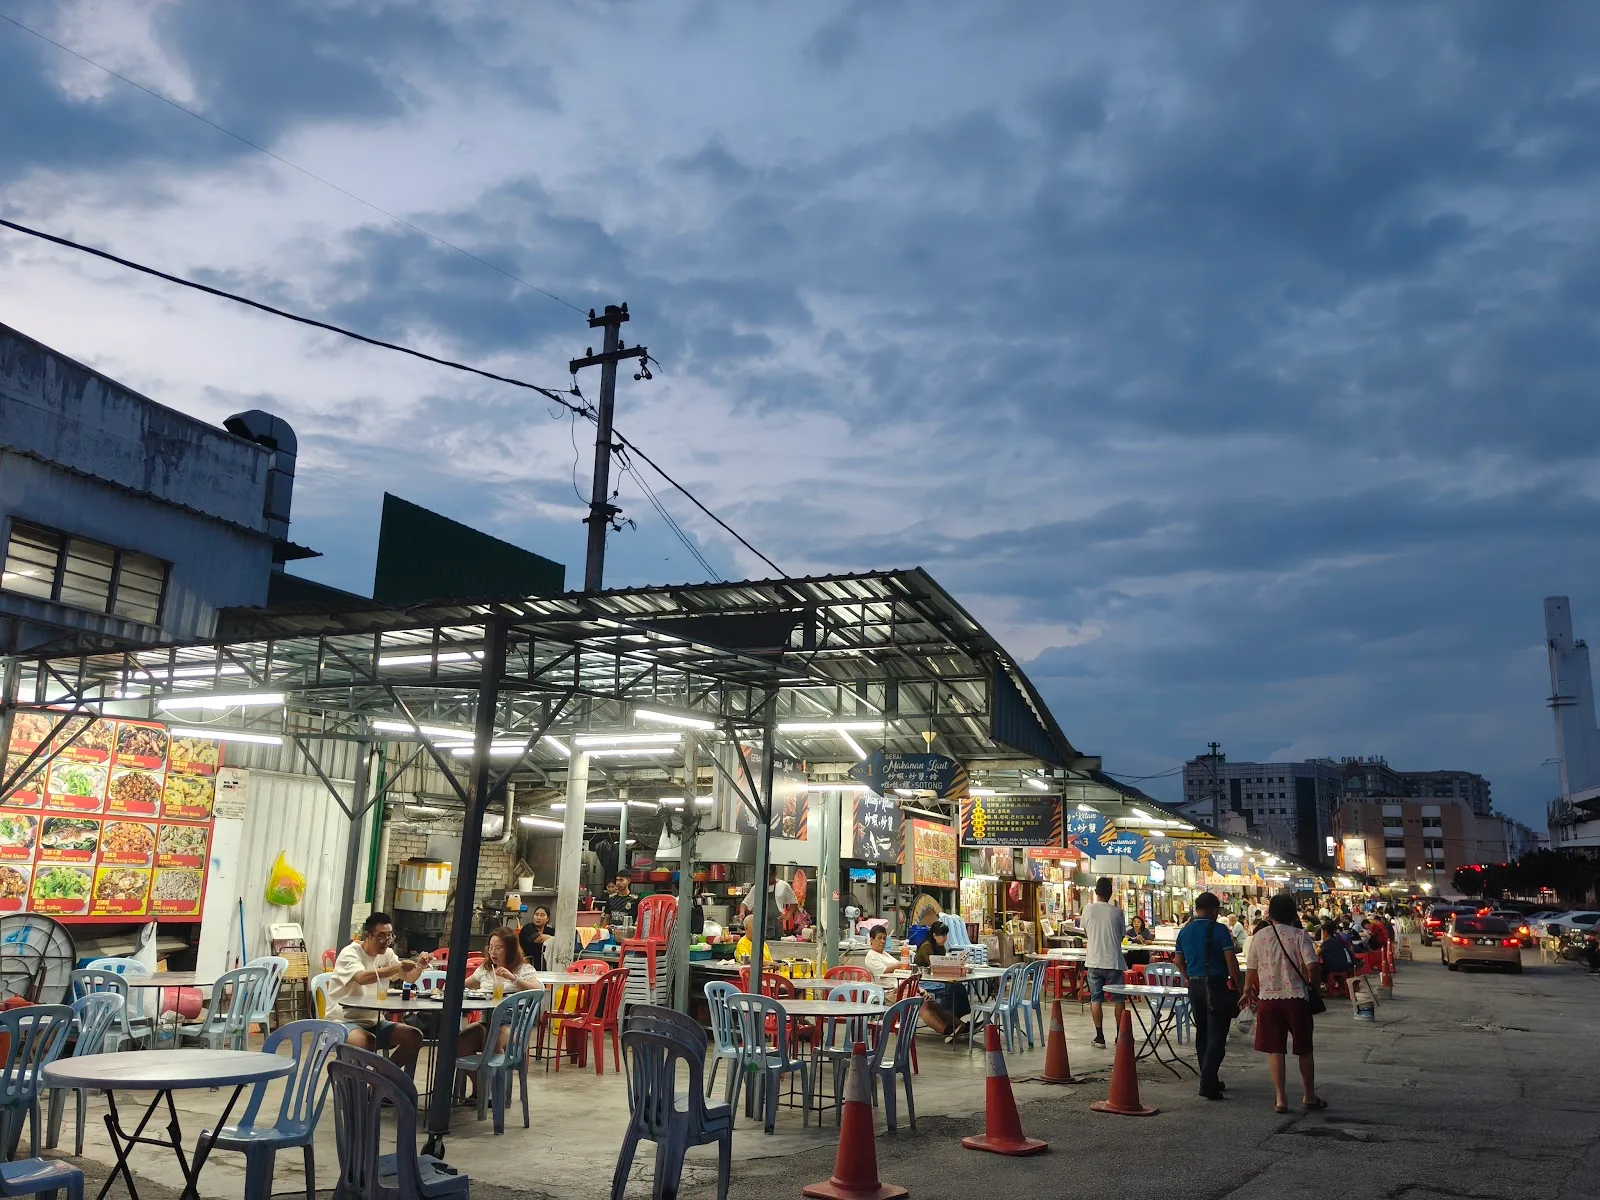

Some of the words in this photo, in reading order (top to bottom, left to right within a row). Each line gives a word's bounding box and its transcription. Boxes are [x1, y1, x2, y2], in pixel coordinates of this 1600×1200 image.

[867, 763, 873, 777] 1
[882, 760, 924, 773] Makanan
[927, 759, 949, 773] Laut
